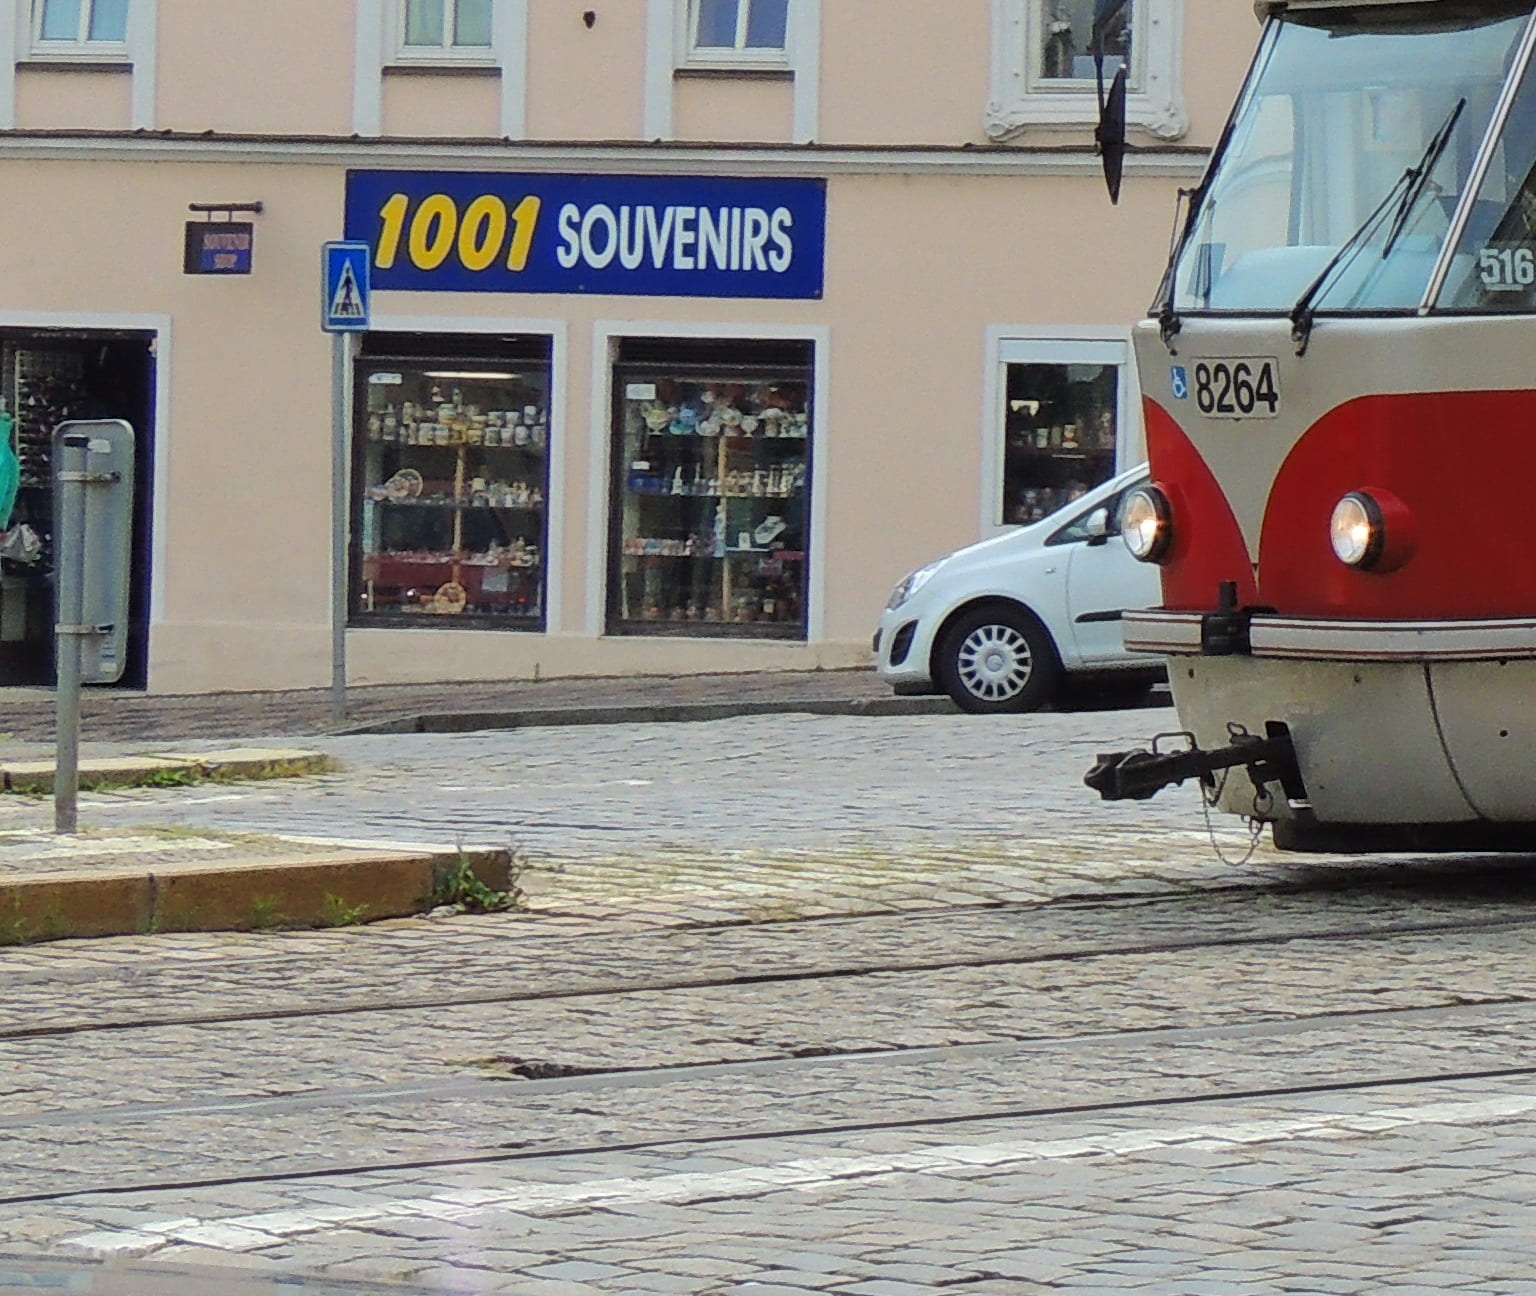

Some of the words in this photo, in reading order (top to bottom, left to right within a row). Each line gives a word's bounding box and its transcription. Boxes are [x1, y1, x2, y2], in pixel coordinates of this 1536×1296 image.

[374, 192, 542, 272] 1001
[556, 203, 794, 274] SOUVENIRS
[1479, 248, 1535, 285] 516
[1195, 362, 1279, 414] 8264
